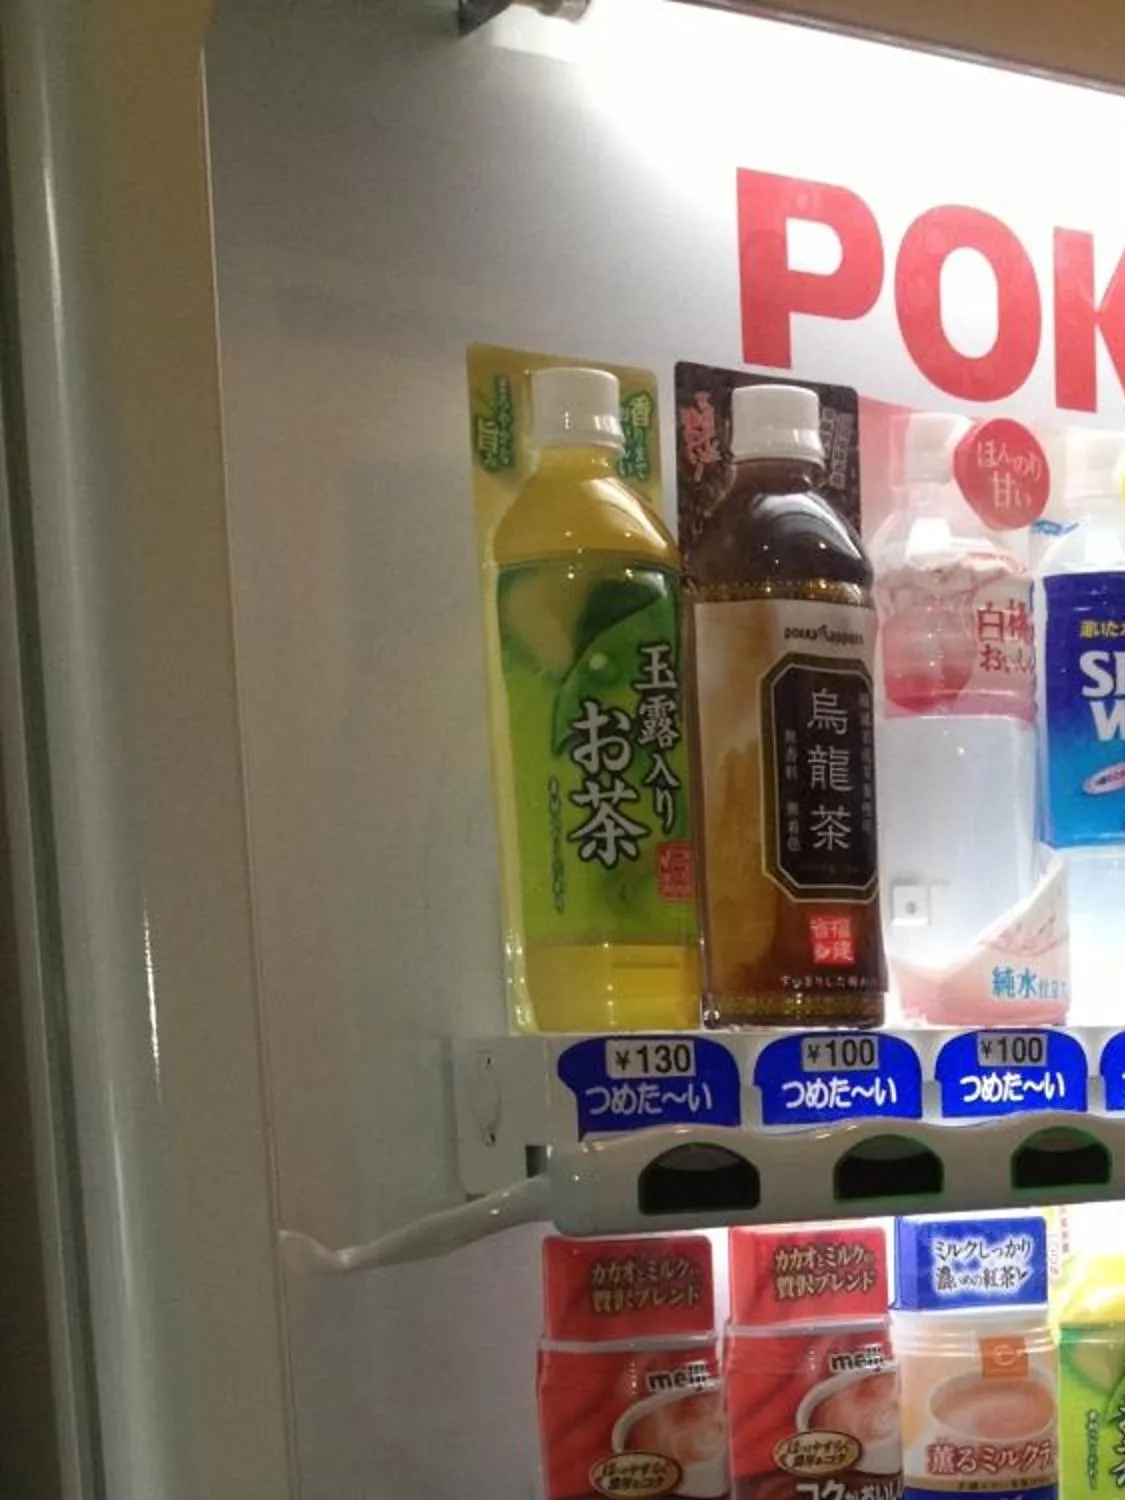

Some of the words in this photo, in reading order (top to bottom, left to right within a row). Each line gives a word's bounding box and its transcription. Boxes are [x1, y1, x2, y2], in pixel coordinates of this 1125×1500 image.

[977, 441, 1042, 479] ほんのり
[991, 472, 1032, 508] 甘い
[635, 643, 681, 832] 玉露入り
[568, 701, 650, 869] お茶
[806, 687, 855, 853] 烏龍茶
[615, 1044, 691, 1074] ¥130
[806, 1038, 875, 1067] ¥100
[980, 1036, 1043, 1064] ¥100
[934, 1236, 1034, 1262] ミルクしっかり
[830, 1345, 886, 1374] meiji
[648, 1361, 712, 1393] meiji
